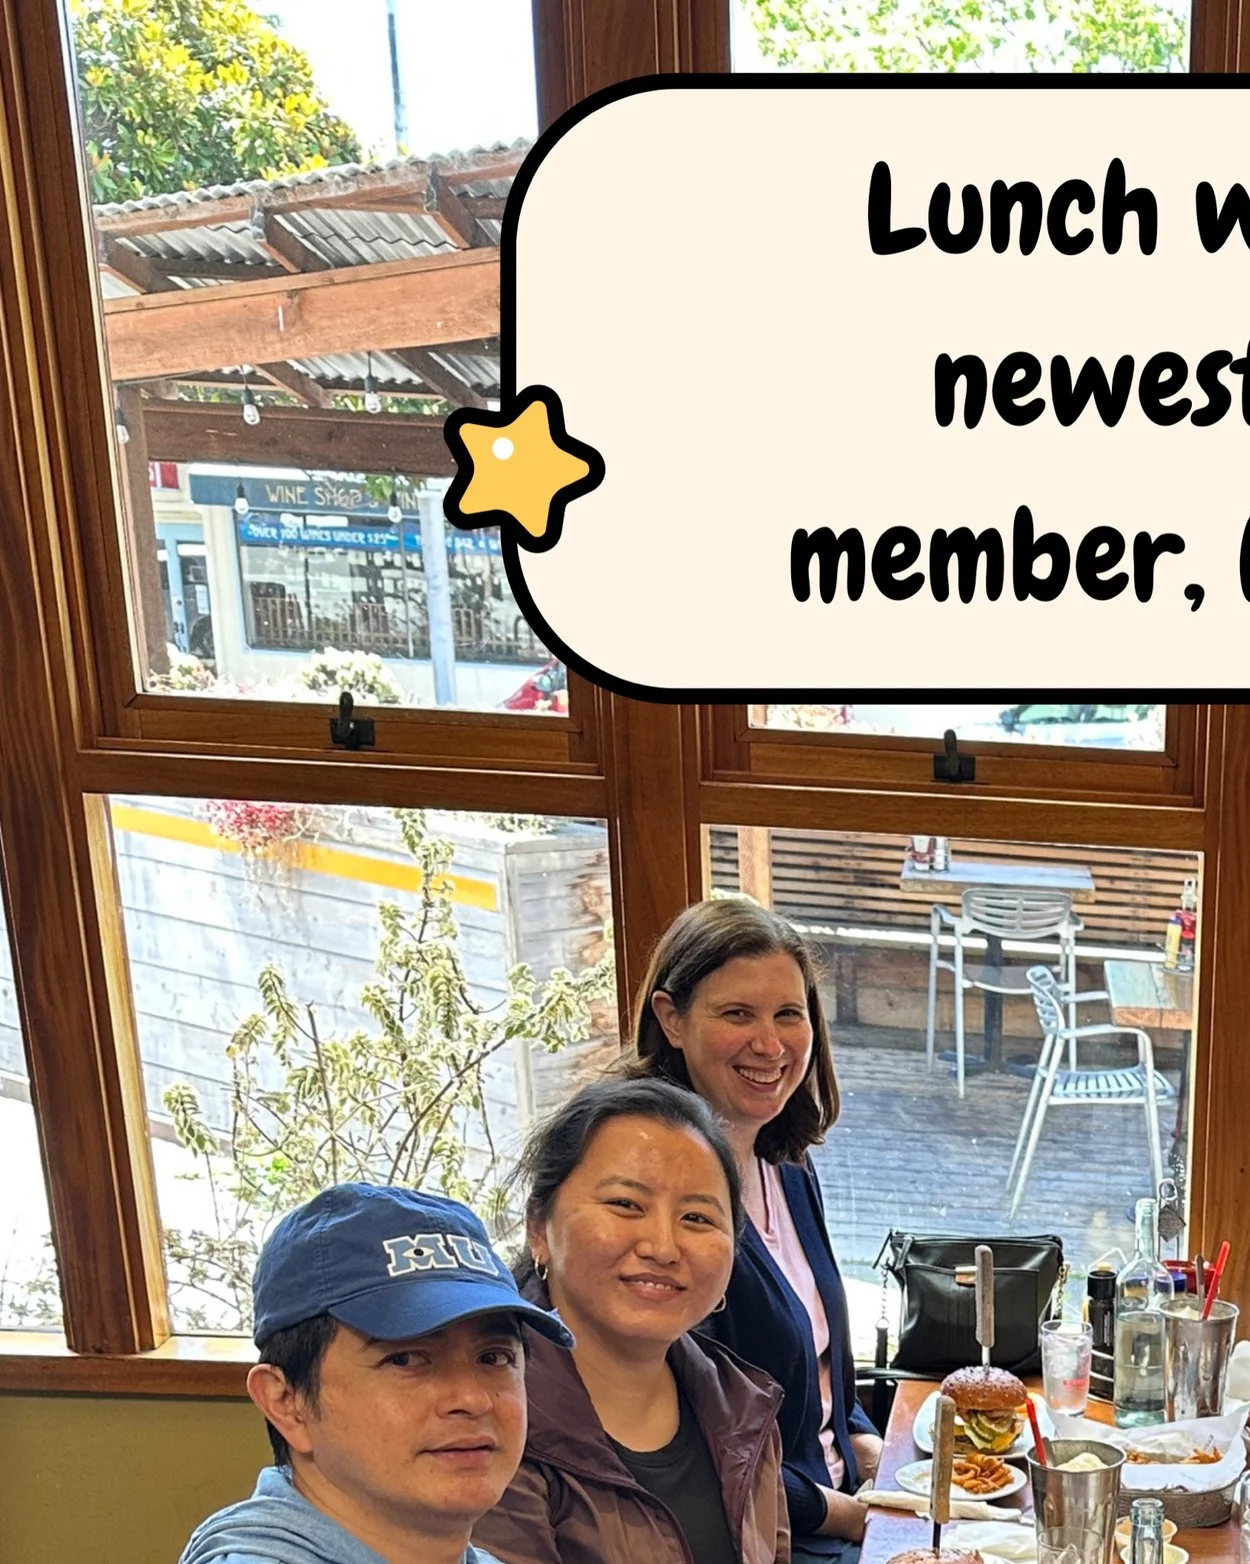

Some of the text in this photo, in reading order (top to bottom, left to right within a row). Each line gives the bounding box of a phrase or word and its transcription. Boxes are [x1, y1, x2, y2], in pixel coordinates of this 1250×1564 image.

[265, 484, 308, 504] WINE
[314, 486, 361, 507] SHOP
[333, 530, 365, 544] UNDER
[383, 1233, 499, 1277] MU
